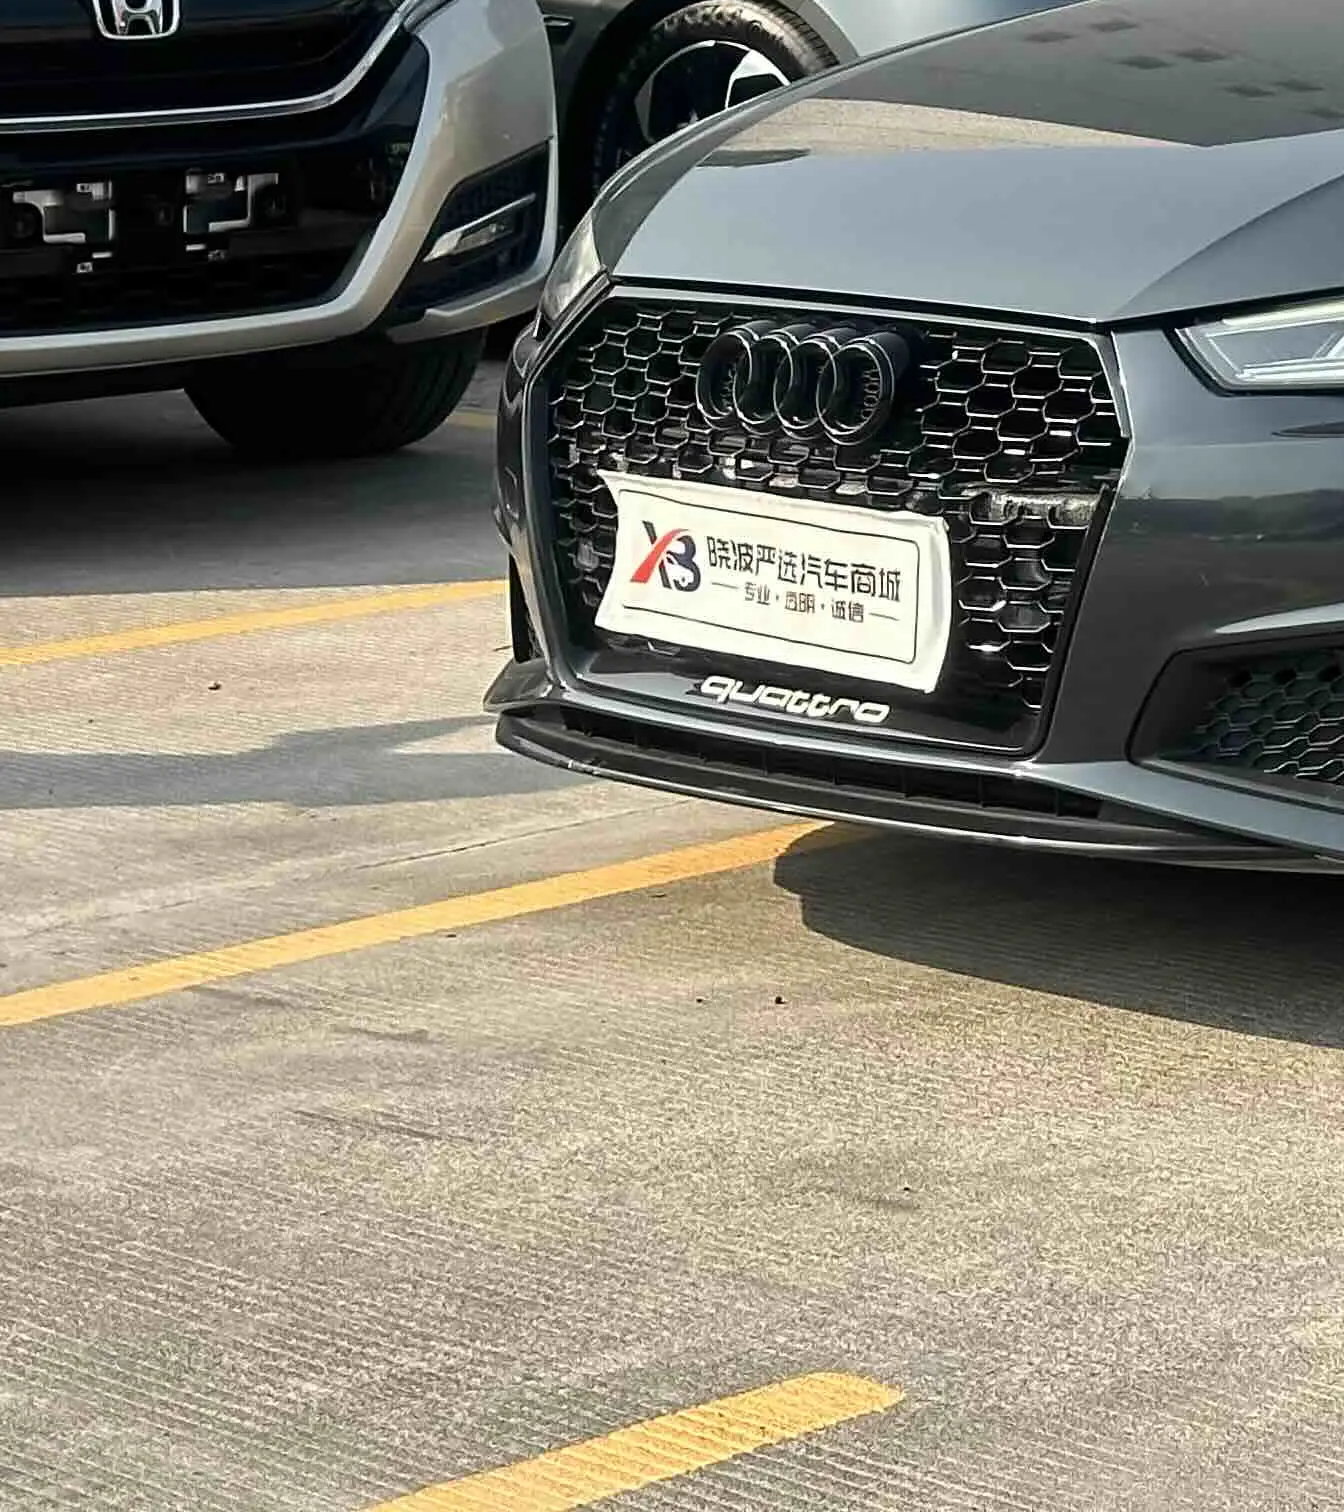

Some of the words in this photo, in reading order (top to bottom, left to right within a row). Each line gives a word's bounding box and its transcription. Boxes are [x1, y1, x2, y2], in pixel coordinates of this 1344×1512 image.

[705, 535, 902, 603] 晓波严选汽车商城
[698, 675, 890, 724] quattro
